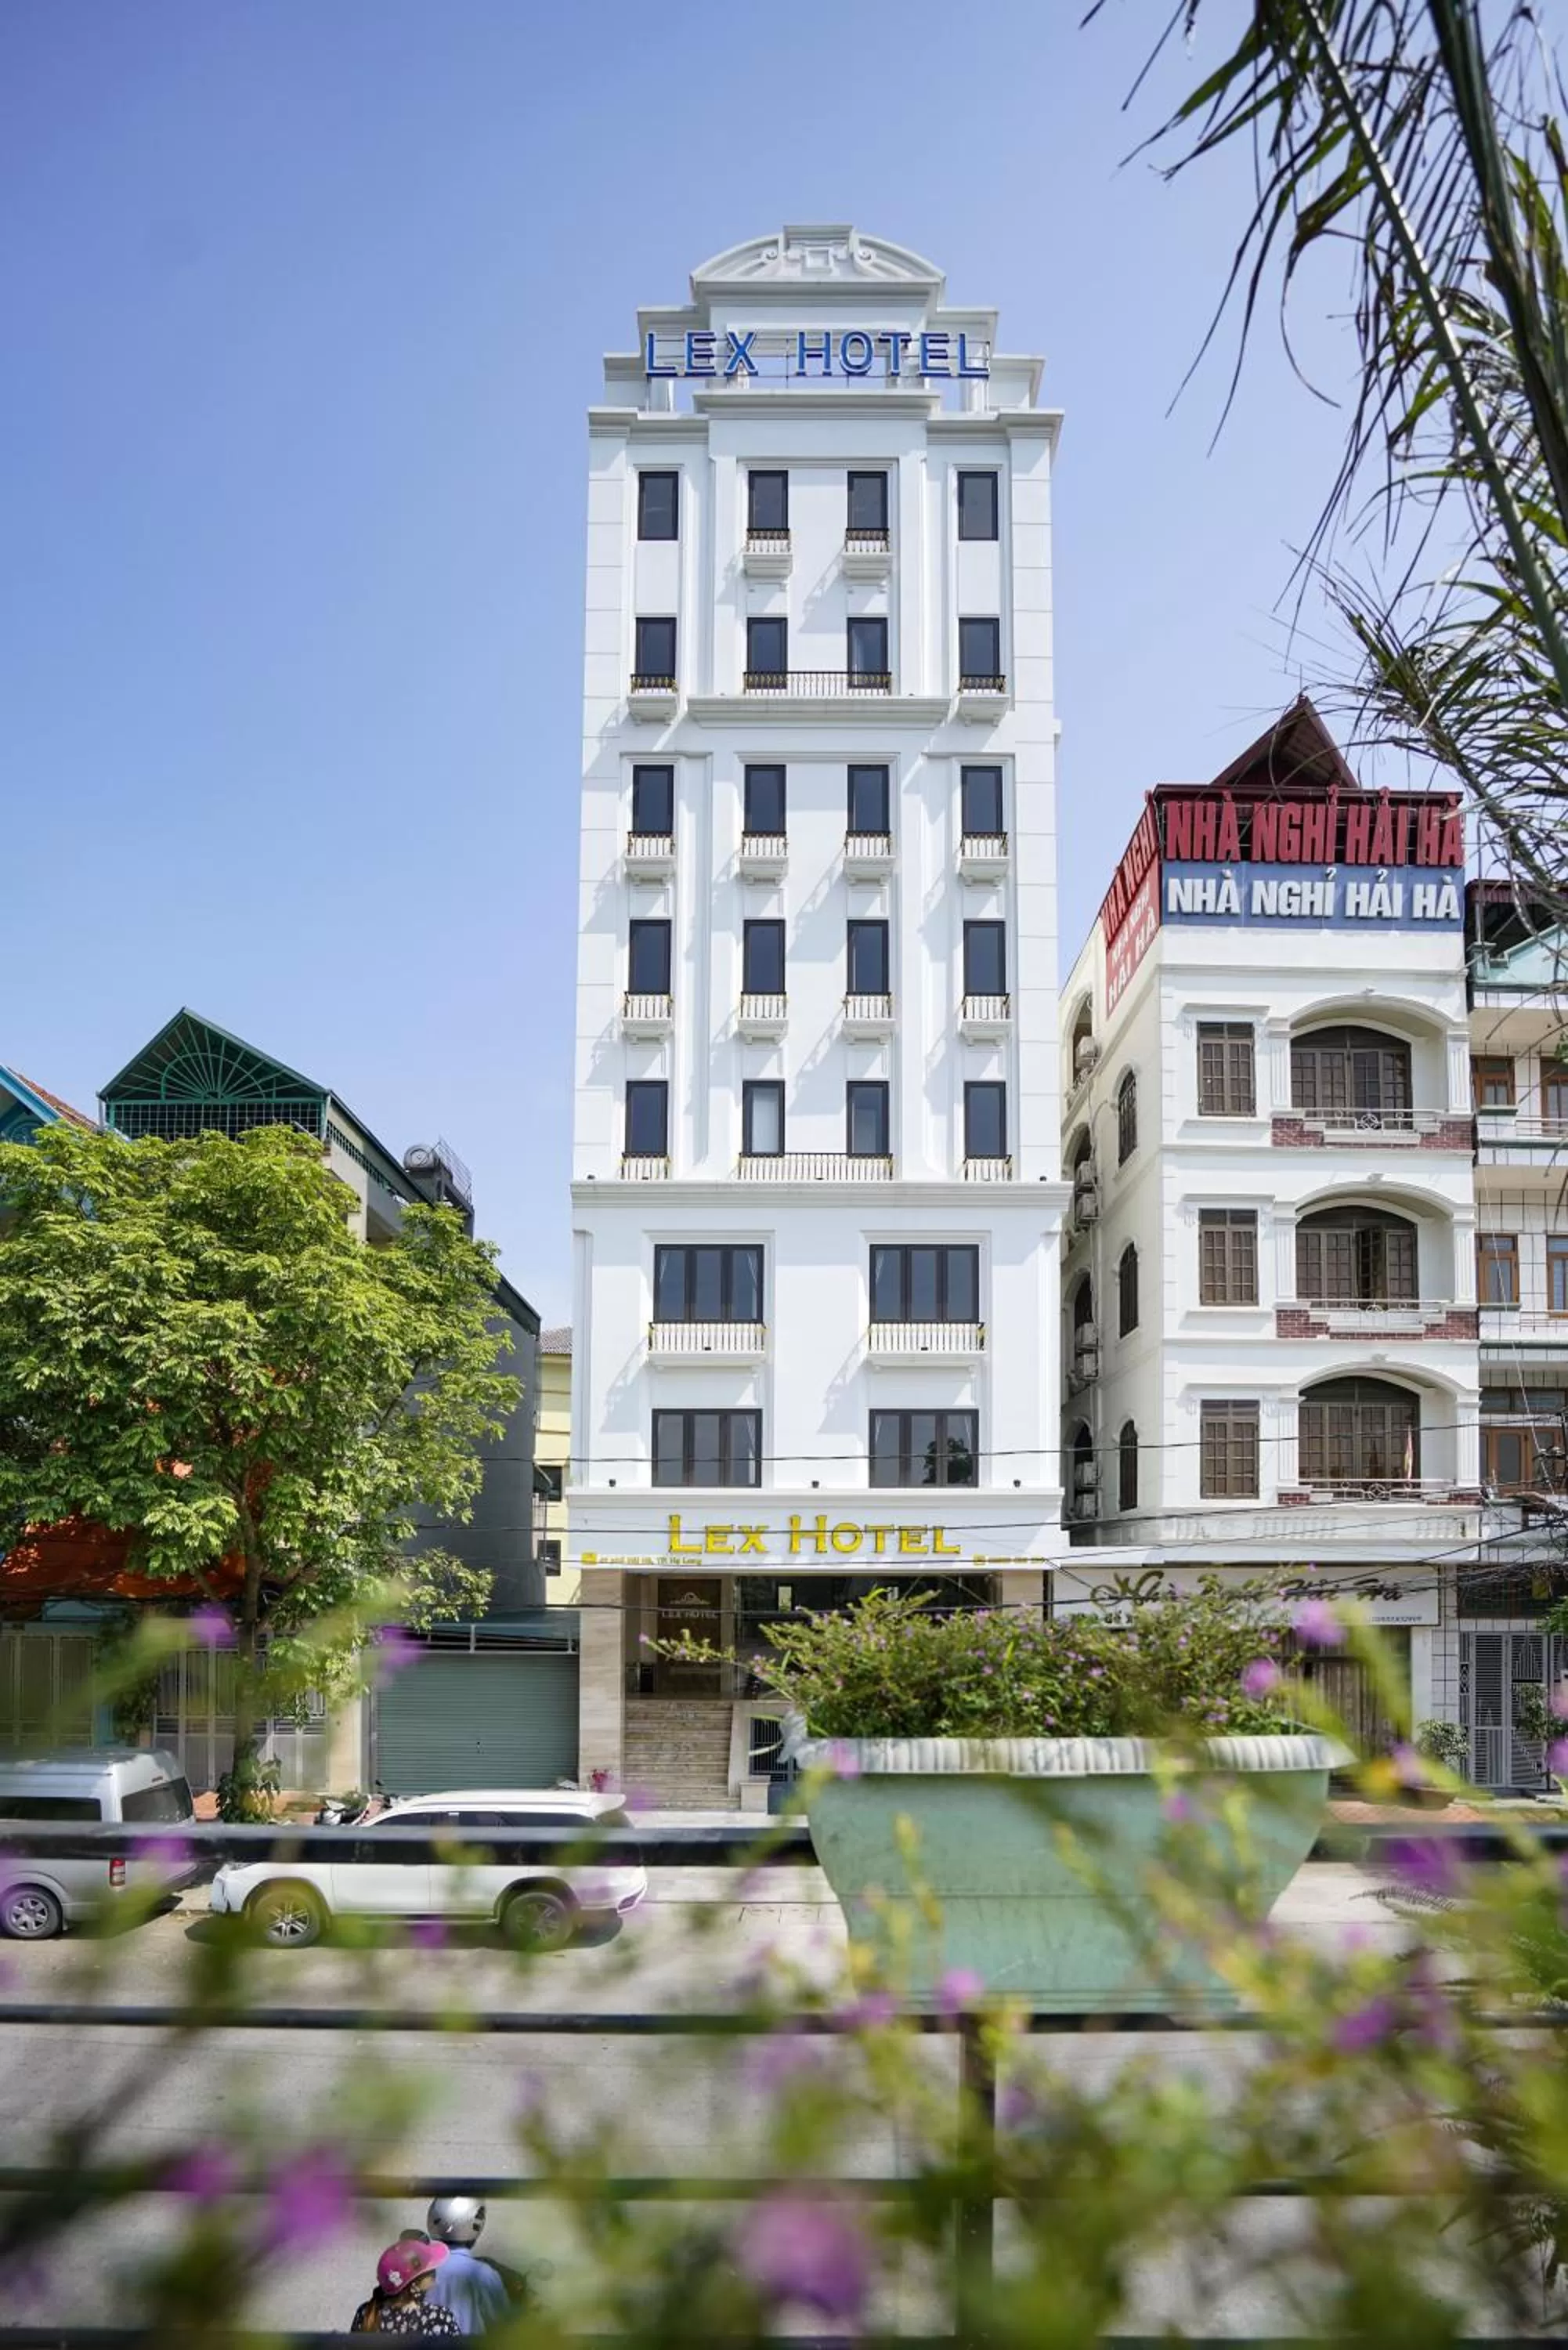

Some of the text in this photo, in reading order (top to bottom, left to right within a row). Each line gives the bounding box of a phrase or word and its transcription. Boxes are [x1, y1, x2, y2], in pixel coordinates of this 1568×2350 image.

[645, 331, 989, 377] LEX HOTEL
[1167, 783, 1464, 866] NHÀ NGHỈ HẢI HÀ
[1168, 867, 1460, 920] NHÀ NGHỈ HẢI HÀ
